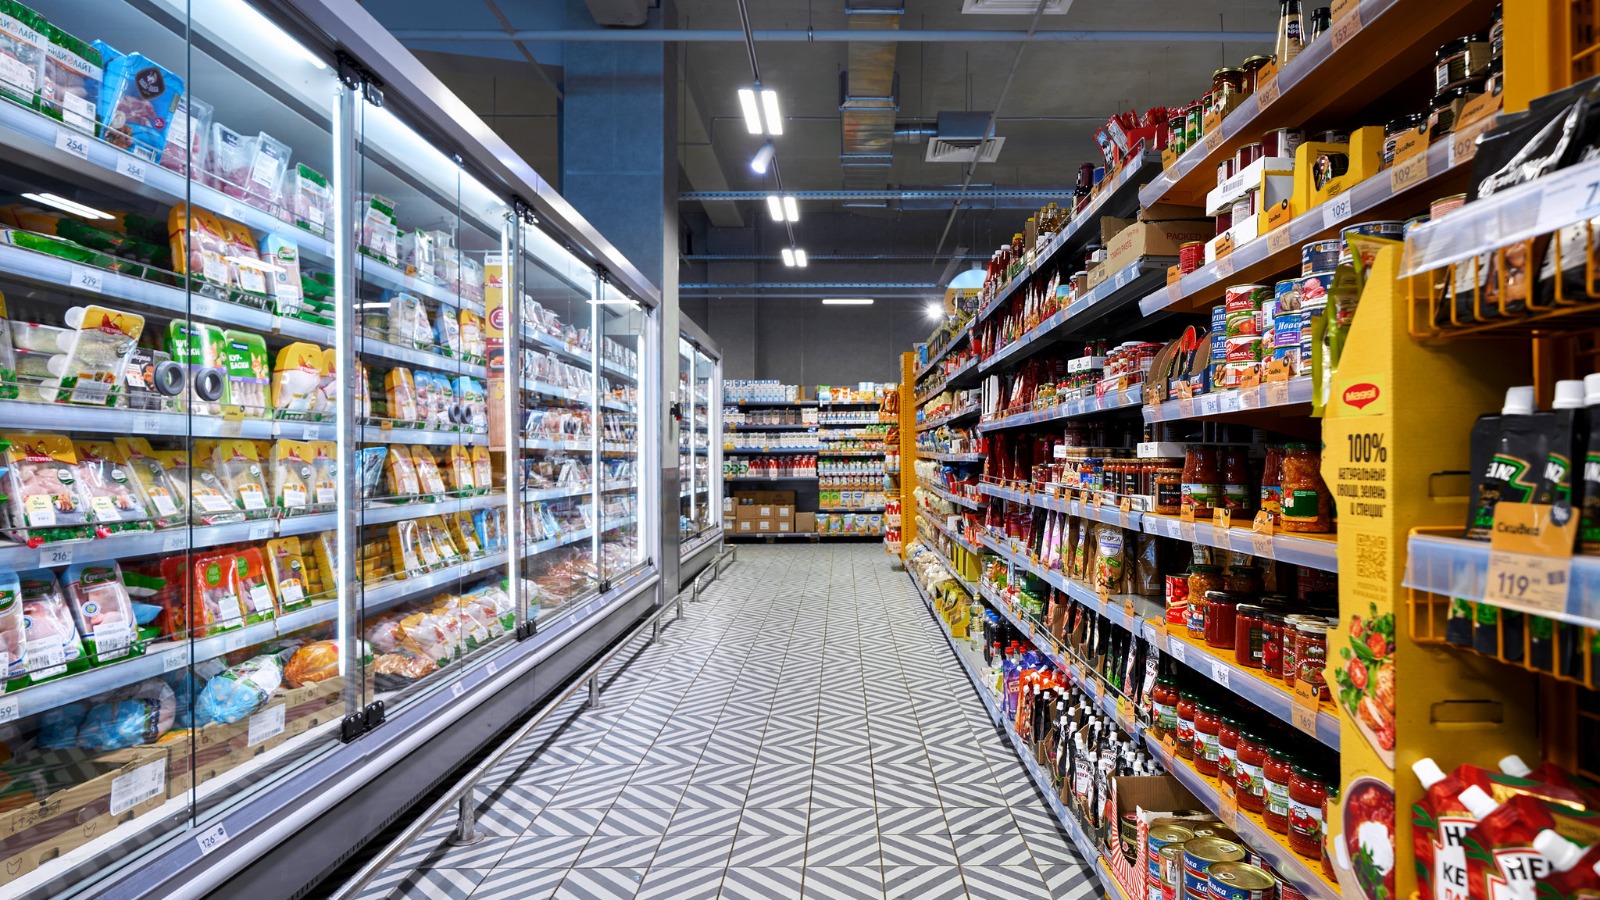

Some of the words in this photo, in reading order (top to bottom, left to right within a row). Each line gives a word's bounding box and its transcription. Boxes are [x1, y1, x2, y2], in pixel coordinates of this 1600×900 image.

[1334, 26, 1348, 43] 159
[66, 136, 84, 153] 254
[1396, 140, 1415, 155] Скидка
[1393, 168, 1410, 185] 109
[1332, 202, 1346, 217] 109
[1268, 211, 1282, 224] Скидка
[1166, 231, 1201, 241] PACKED
[82, 275, 97, 287] 279
[1345, 387, 1377, 402] Maggi
[1347, 432, 1387, 464] 100%
[1496, 522, 1541, 537] Скидка
[52, 552, 67, 561] 216
[1497, 570, 1529, 595] 119
[1295, 687, 1309, 699] Скидка
[1299, 713, 1313, 729] 169
[201, 835, 216, 848] 126
